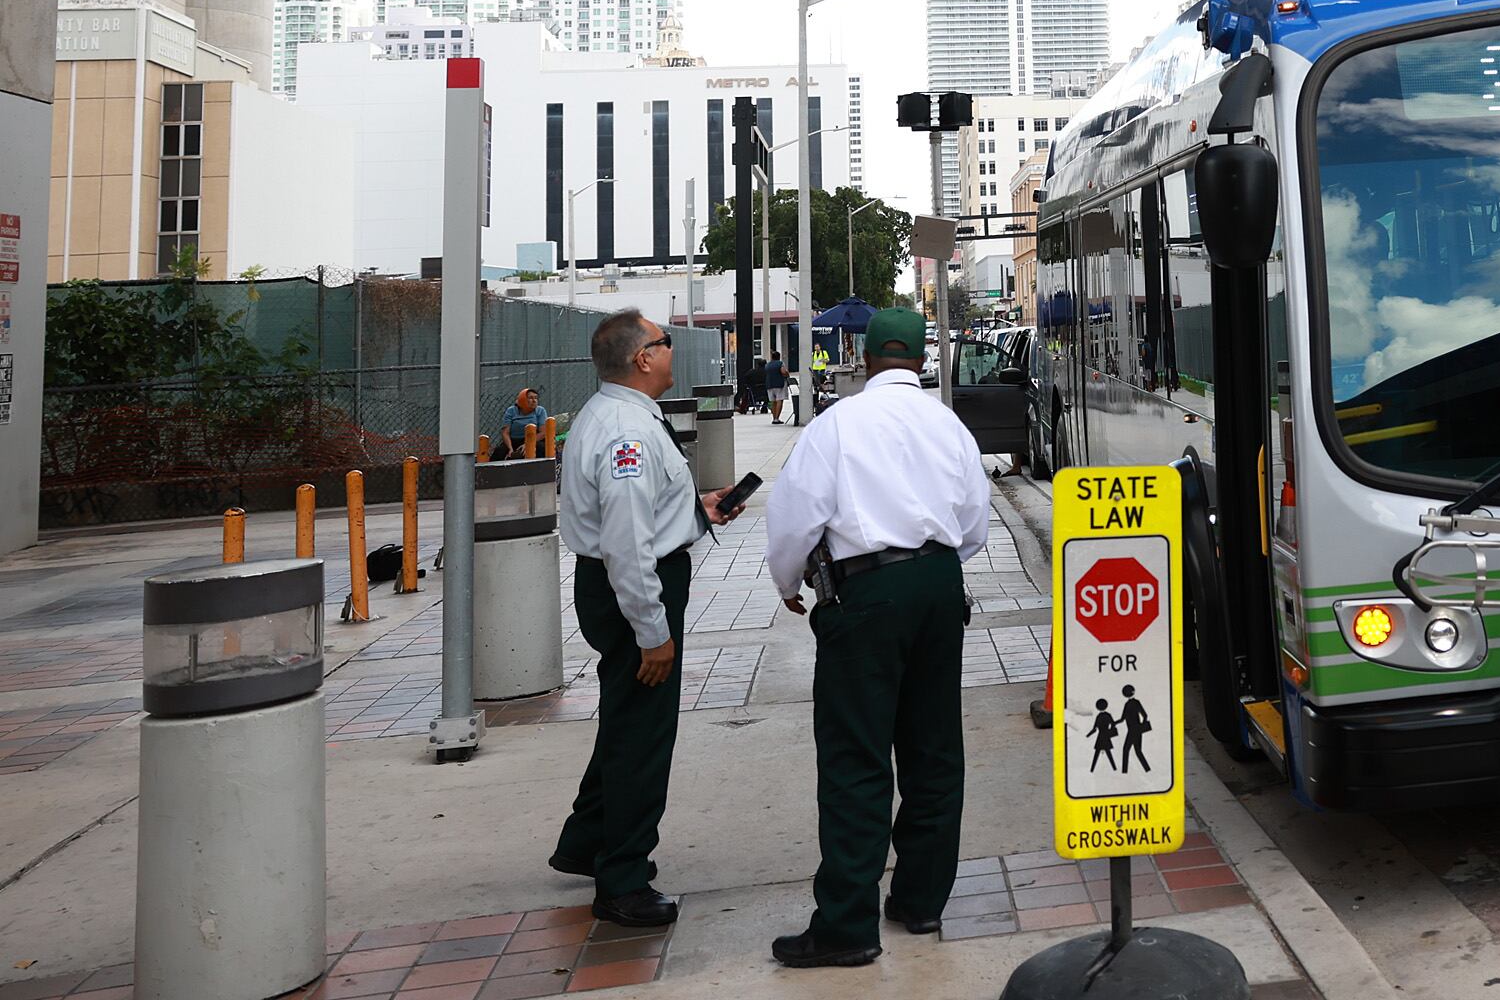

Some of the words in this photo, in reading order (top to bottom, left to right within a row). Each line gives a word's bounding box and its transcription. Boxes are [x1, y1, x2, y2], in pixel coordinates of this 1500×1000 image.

[92, 17, 121, 32] BAR
[706, 77, 770, 88] METRO
[785, 76, 819, 87] AL
[1077, 476, 1158, 501] STATE
[1089, 506, 1144, 530] LAW
[1079, 583, 1155, 617] STOP
[1098, 654, 1137, 673] FOR
[1090, 803, 1149, 823] WITHIN
[1067, 826, 1171, 849] CROSSWALK
